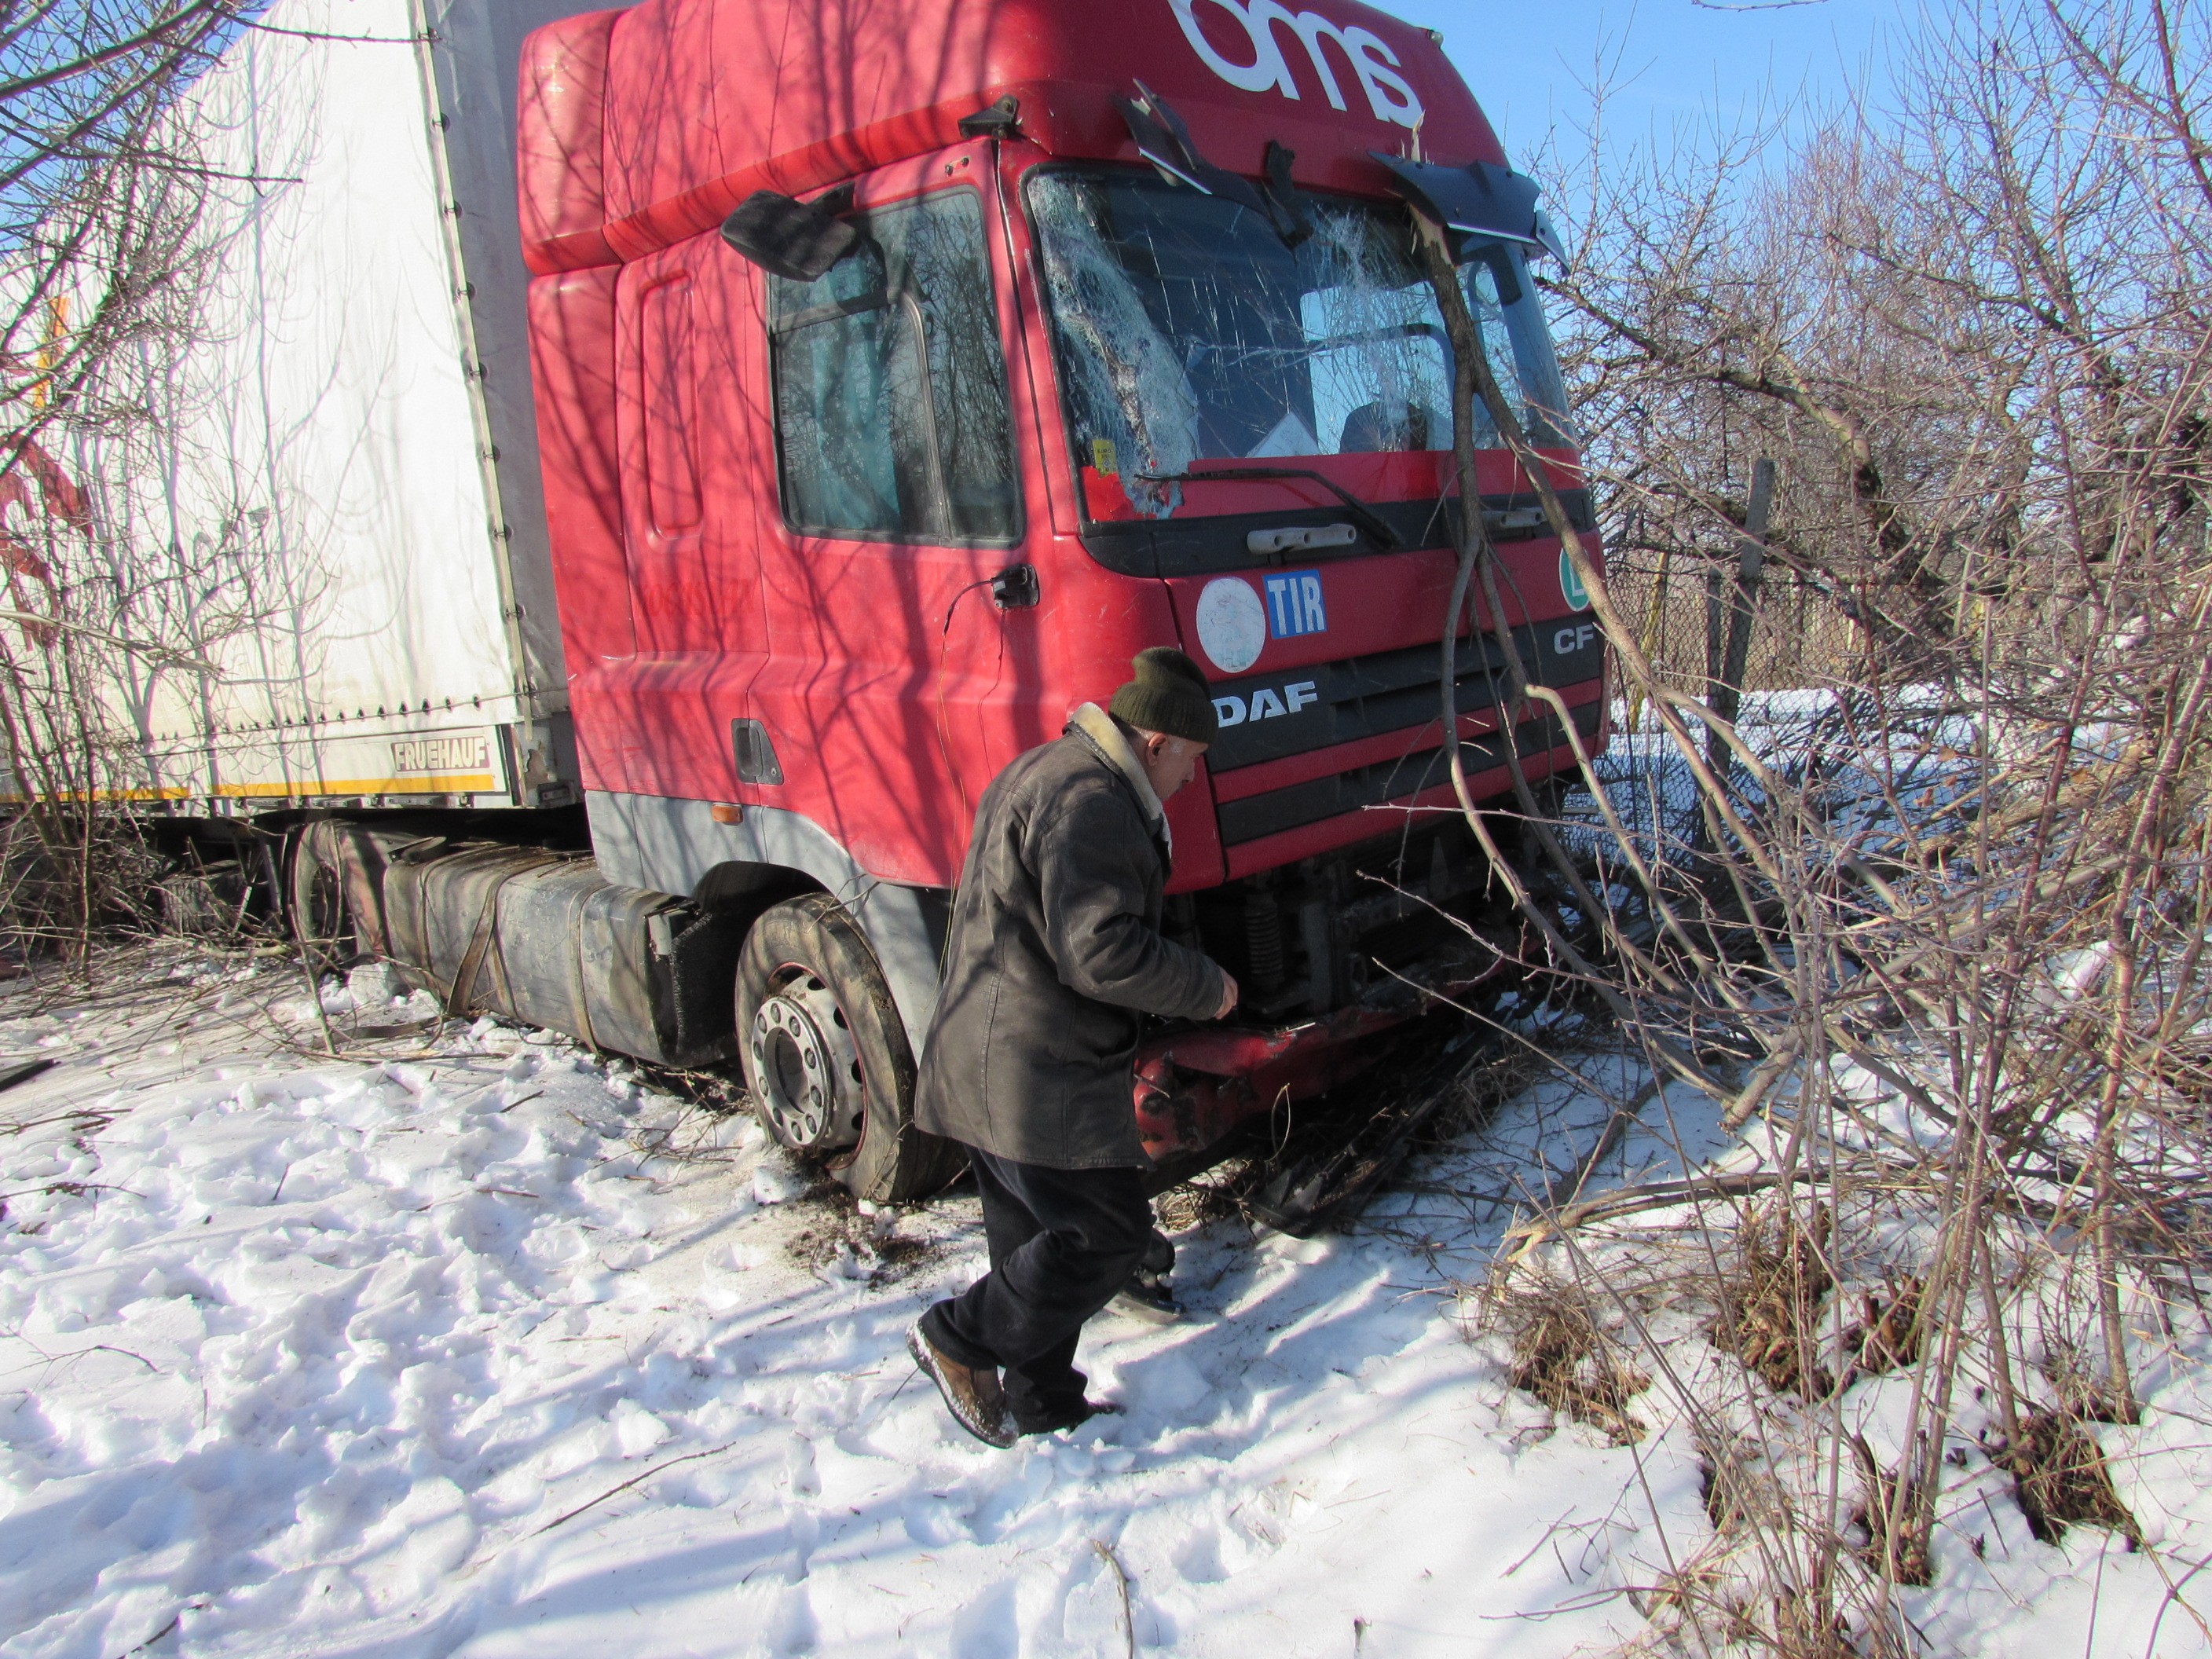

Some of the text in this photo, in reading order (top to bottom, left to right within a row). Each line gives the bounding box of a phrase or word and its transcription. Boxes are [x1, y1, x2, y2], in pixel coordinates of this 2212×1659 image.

[1267, 577, 1325, 636] TIR
[1554, 624, 1595, 654] CF
[1211, 680, 1318, 728] DAF
[394, 737, 486, 771] FRUEHAUF
